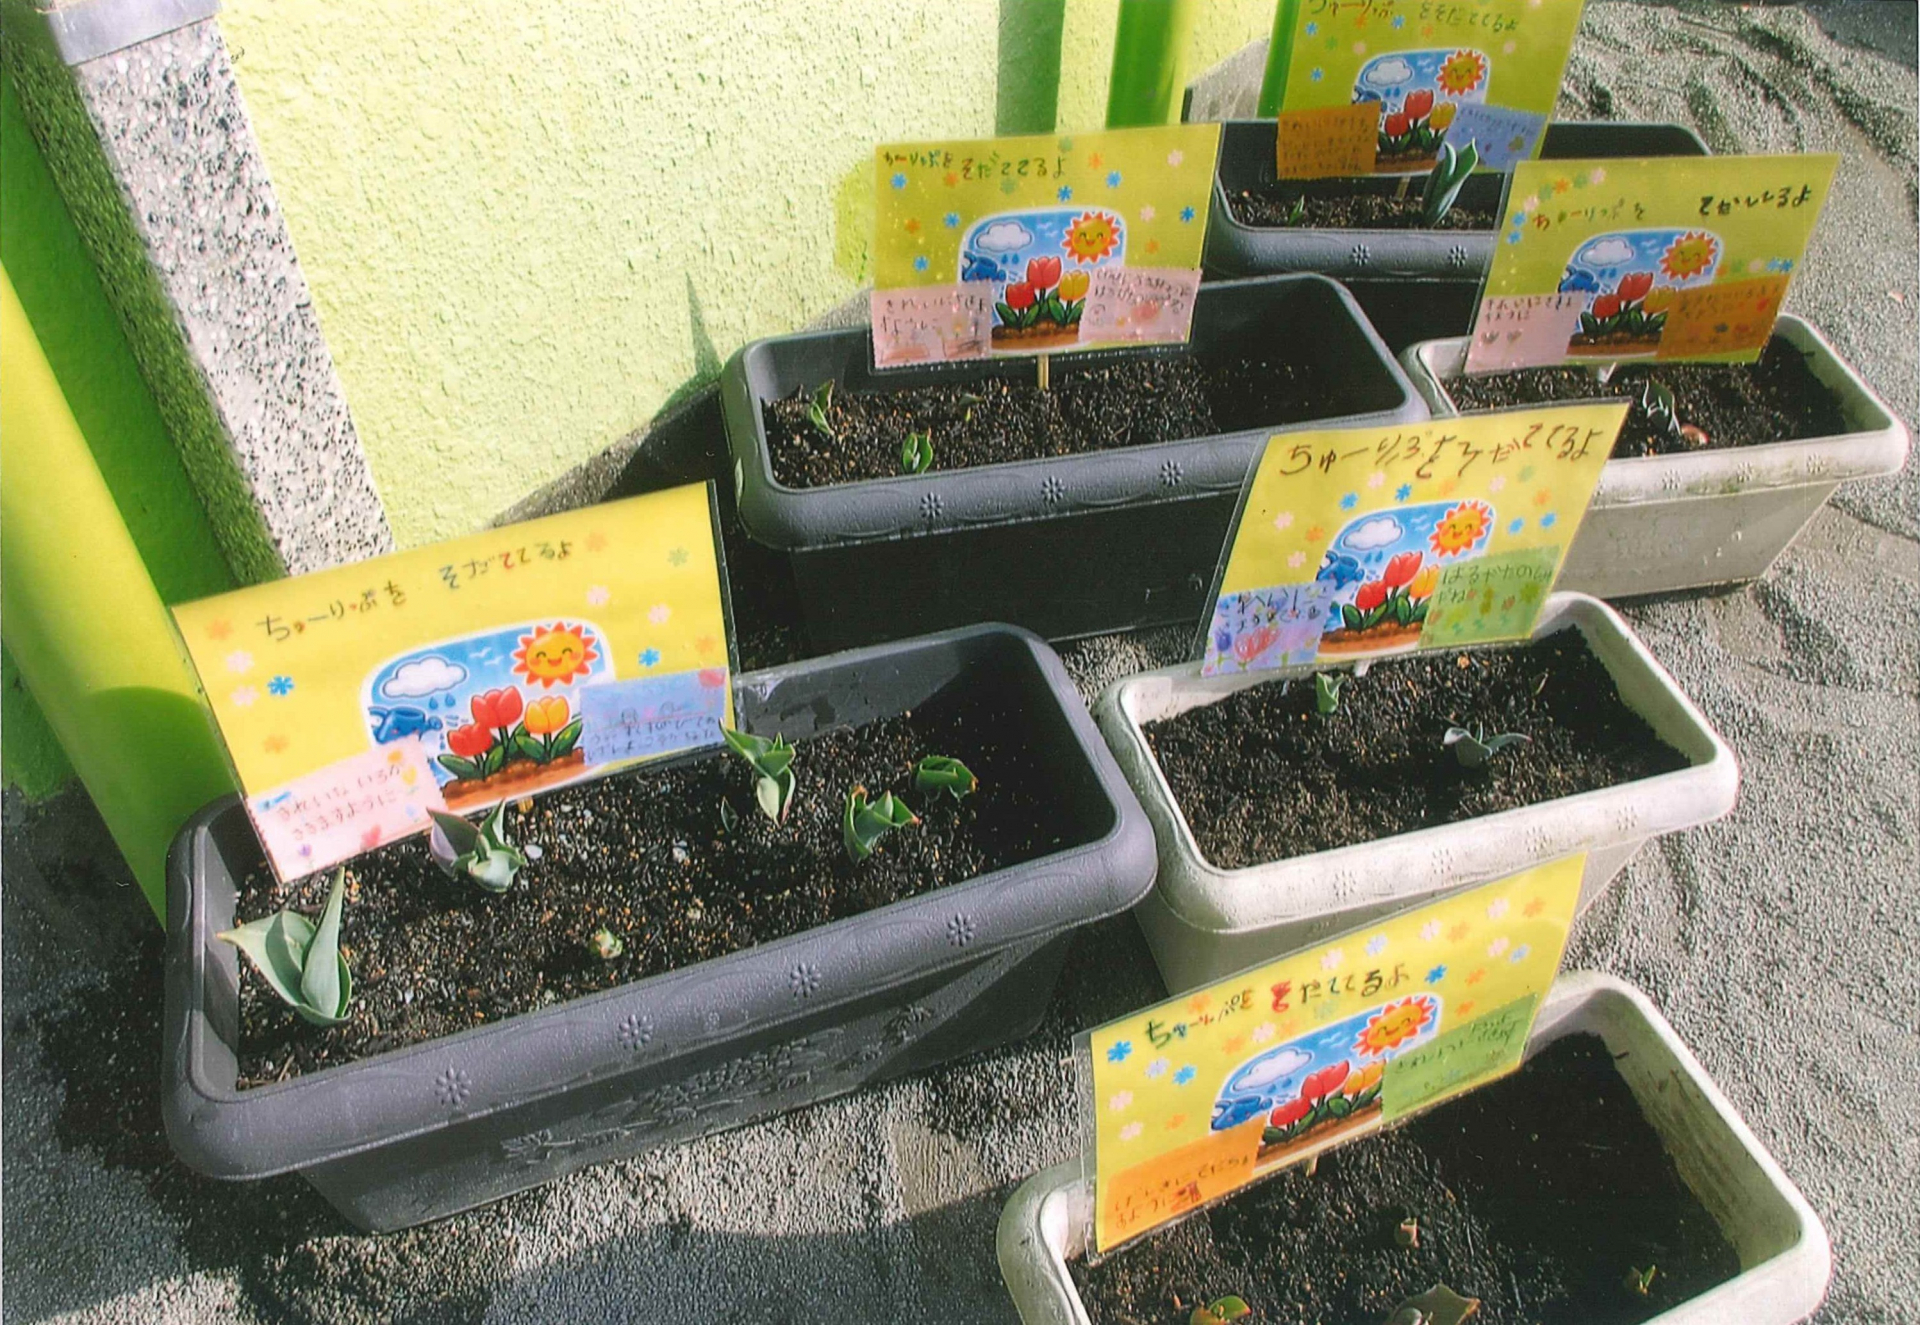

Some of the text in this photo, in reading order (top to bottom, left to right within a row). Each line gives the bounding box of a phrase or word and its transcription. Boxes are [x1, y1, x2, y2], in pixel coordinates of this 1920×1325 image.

[438, 540, 573, 590] そだててるよ
